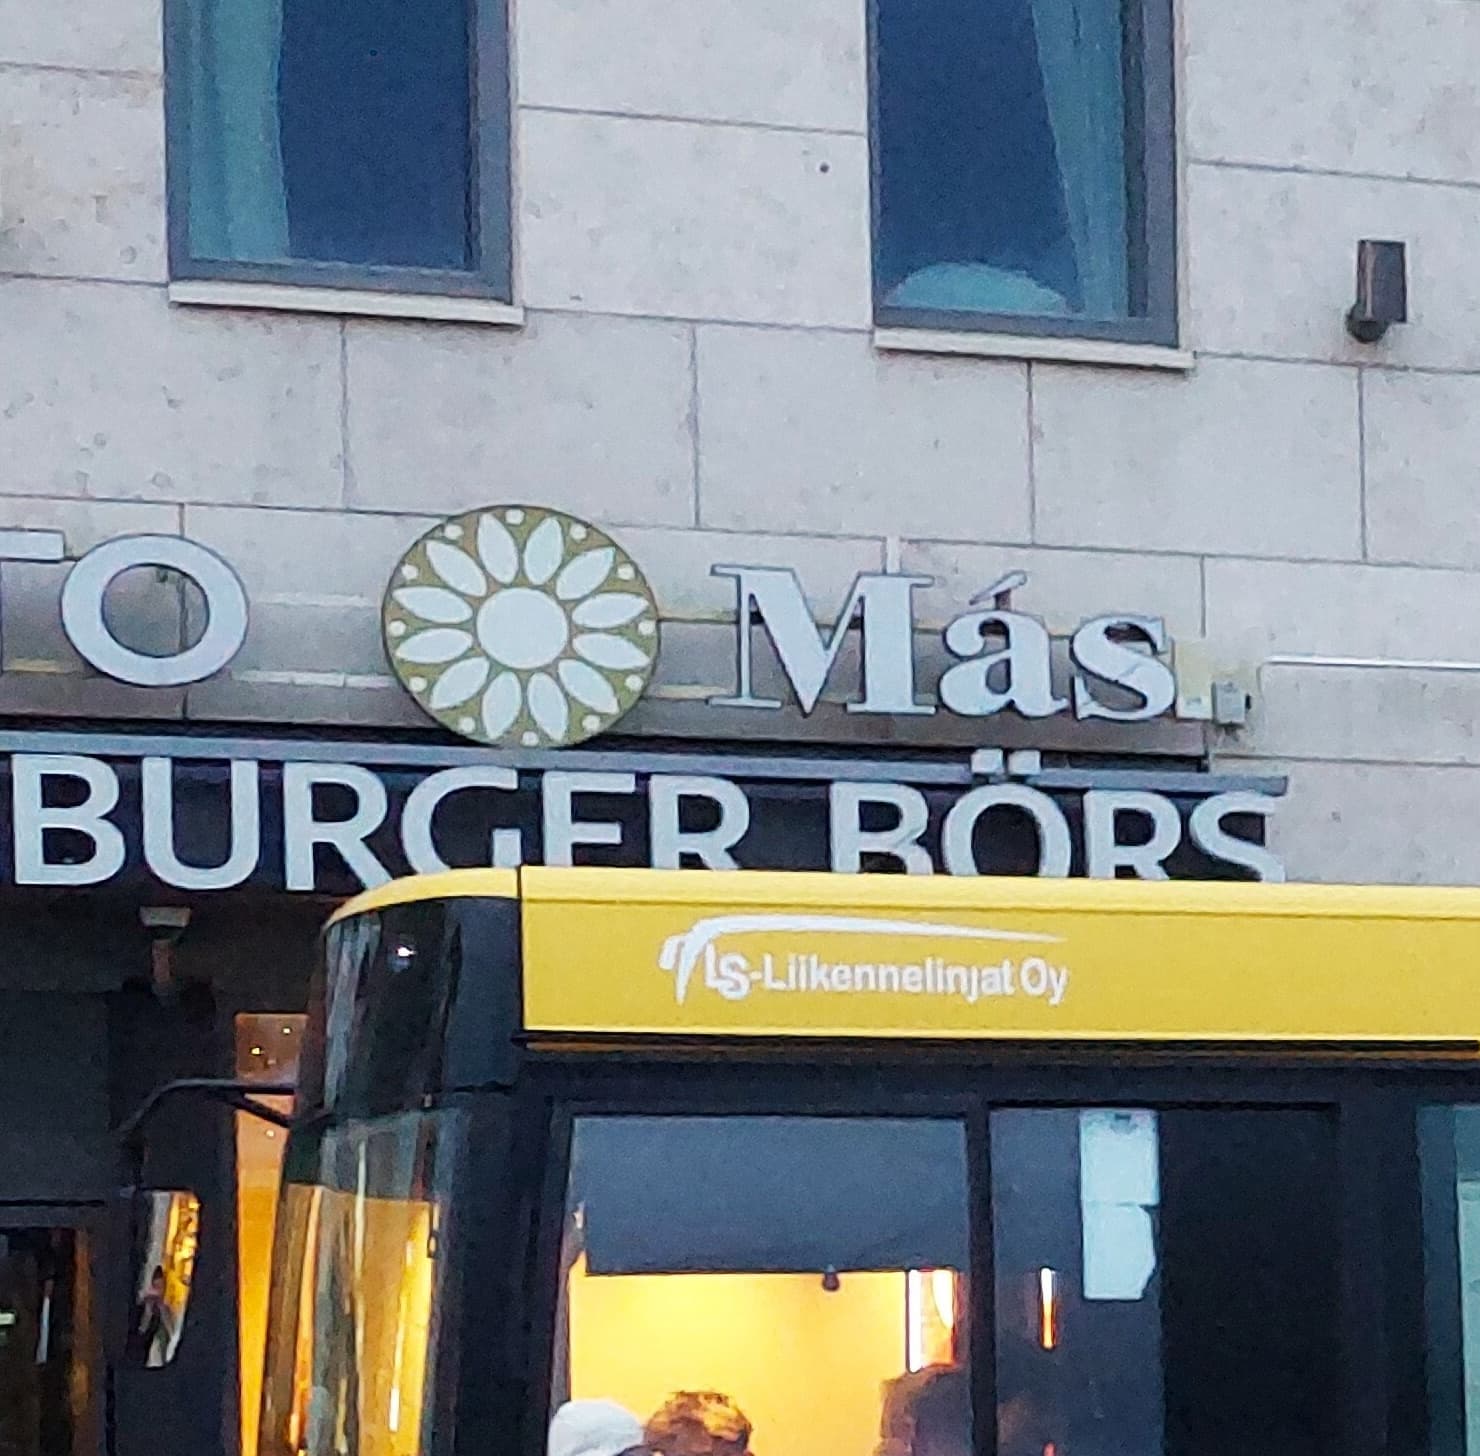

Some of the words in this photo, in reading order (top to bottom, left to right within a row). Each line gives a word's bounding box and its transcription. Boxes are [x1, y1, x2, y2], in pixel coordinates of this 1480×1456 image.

[0, 527, 249, 688] O
[10, 752, 751, 890] BURGER
[829, 747, 1287, 882] BÖRS
[1019, 956, 1068, 1005] Oy
